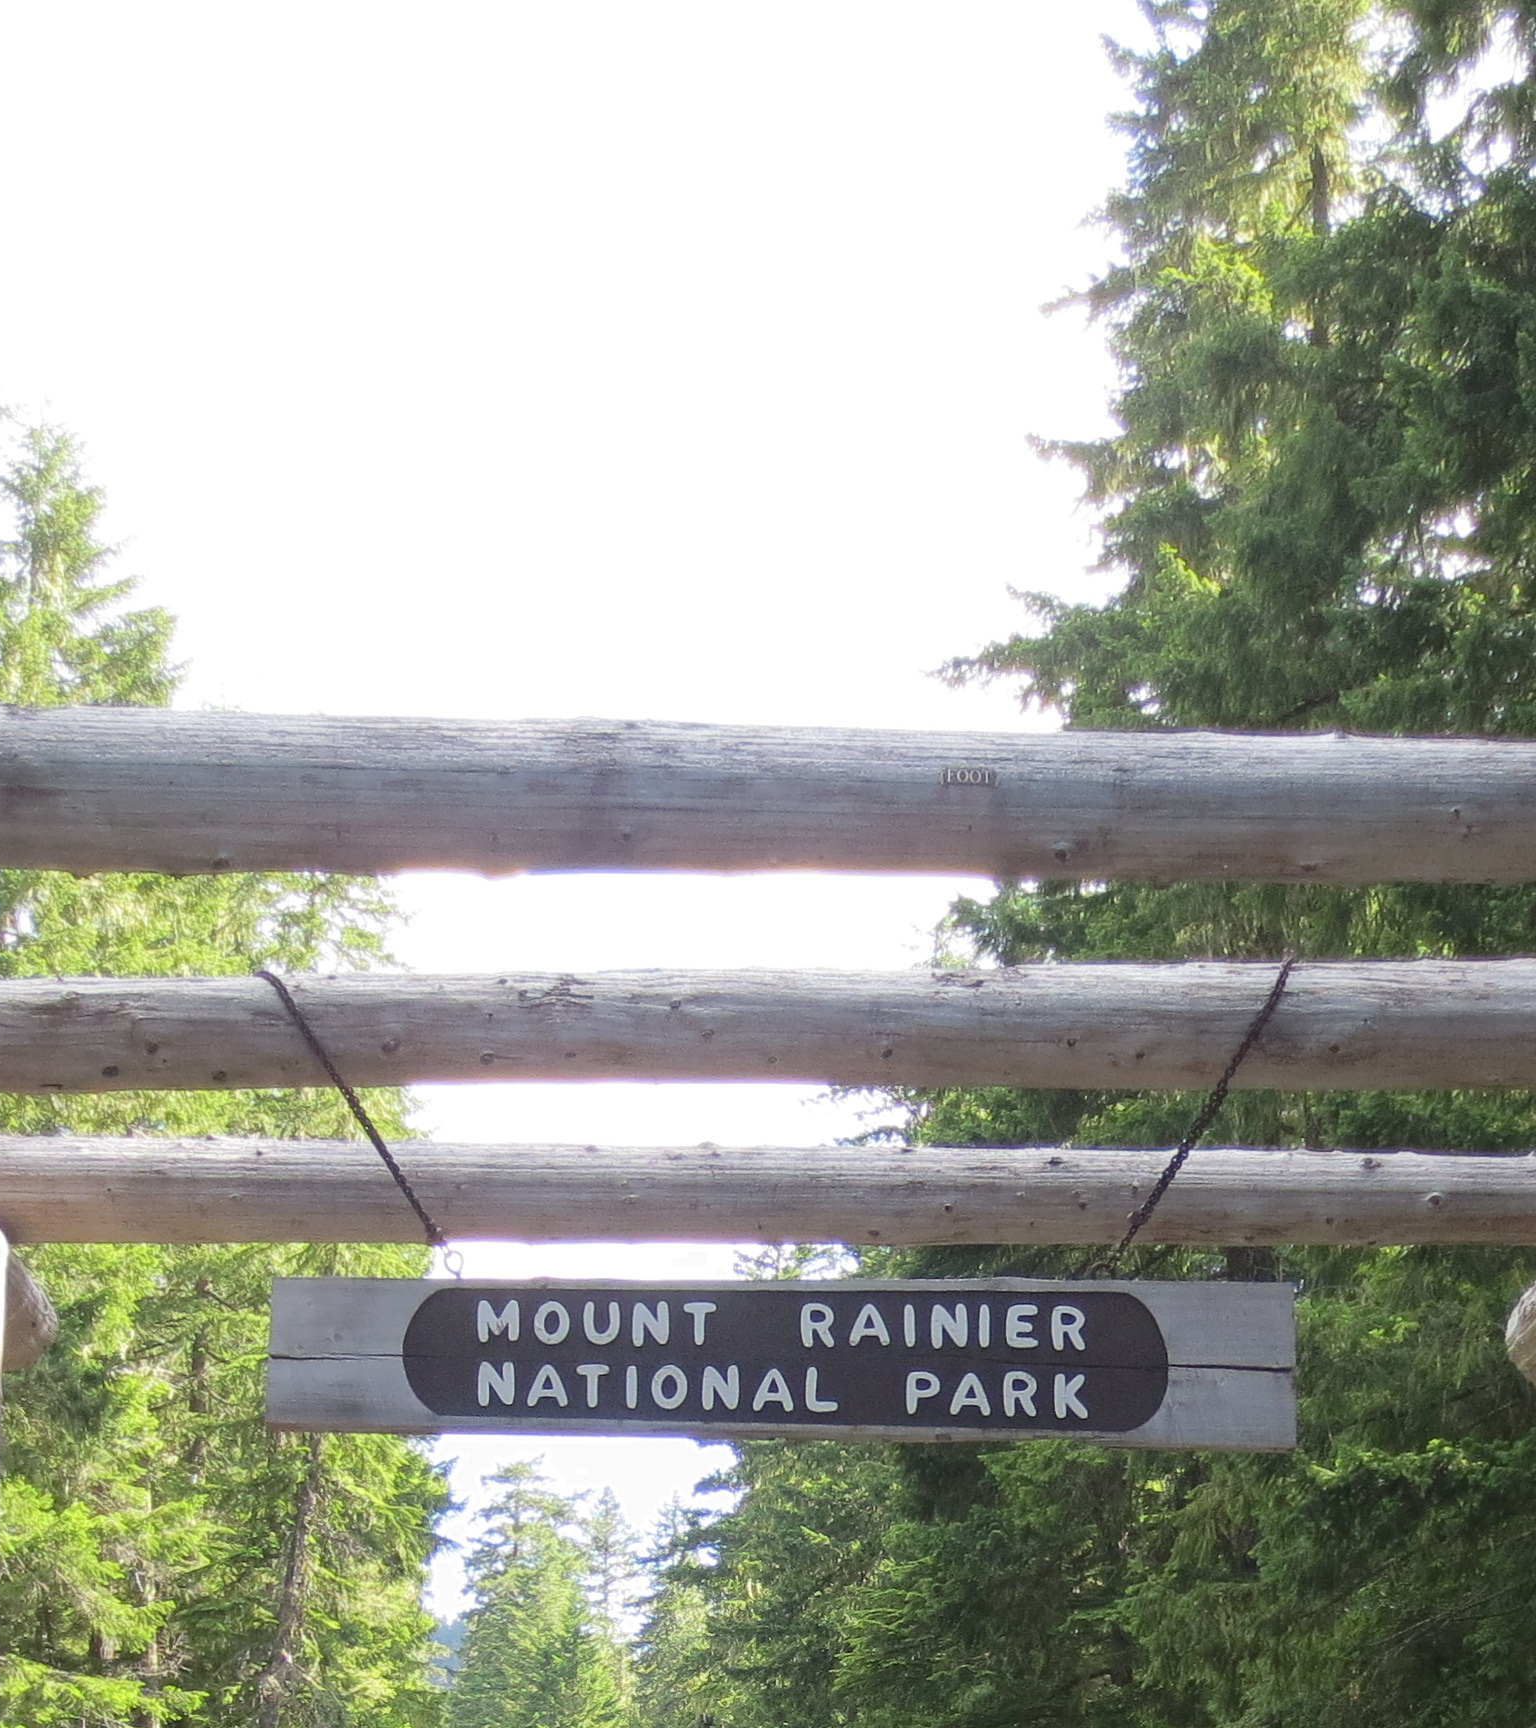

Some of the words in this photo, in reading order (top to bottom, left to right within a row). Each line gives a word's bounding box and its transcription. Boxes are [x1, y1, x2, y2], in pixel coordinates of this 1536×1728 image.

[477, 1299, 718, 1347] MOUNT
[800, 1302, 1087, 1351] RAINIER
[477, 1361, 839, 1413] NATIONAL
[905, 1370, 1089, 1419] PARK
